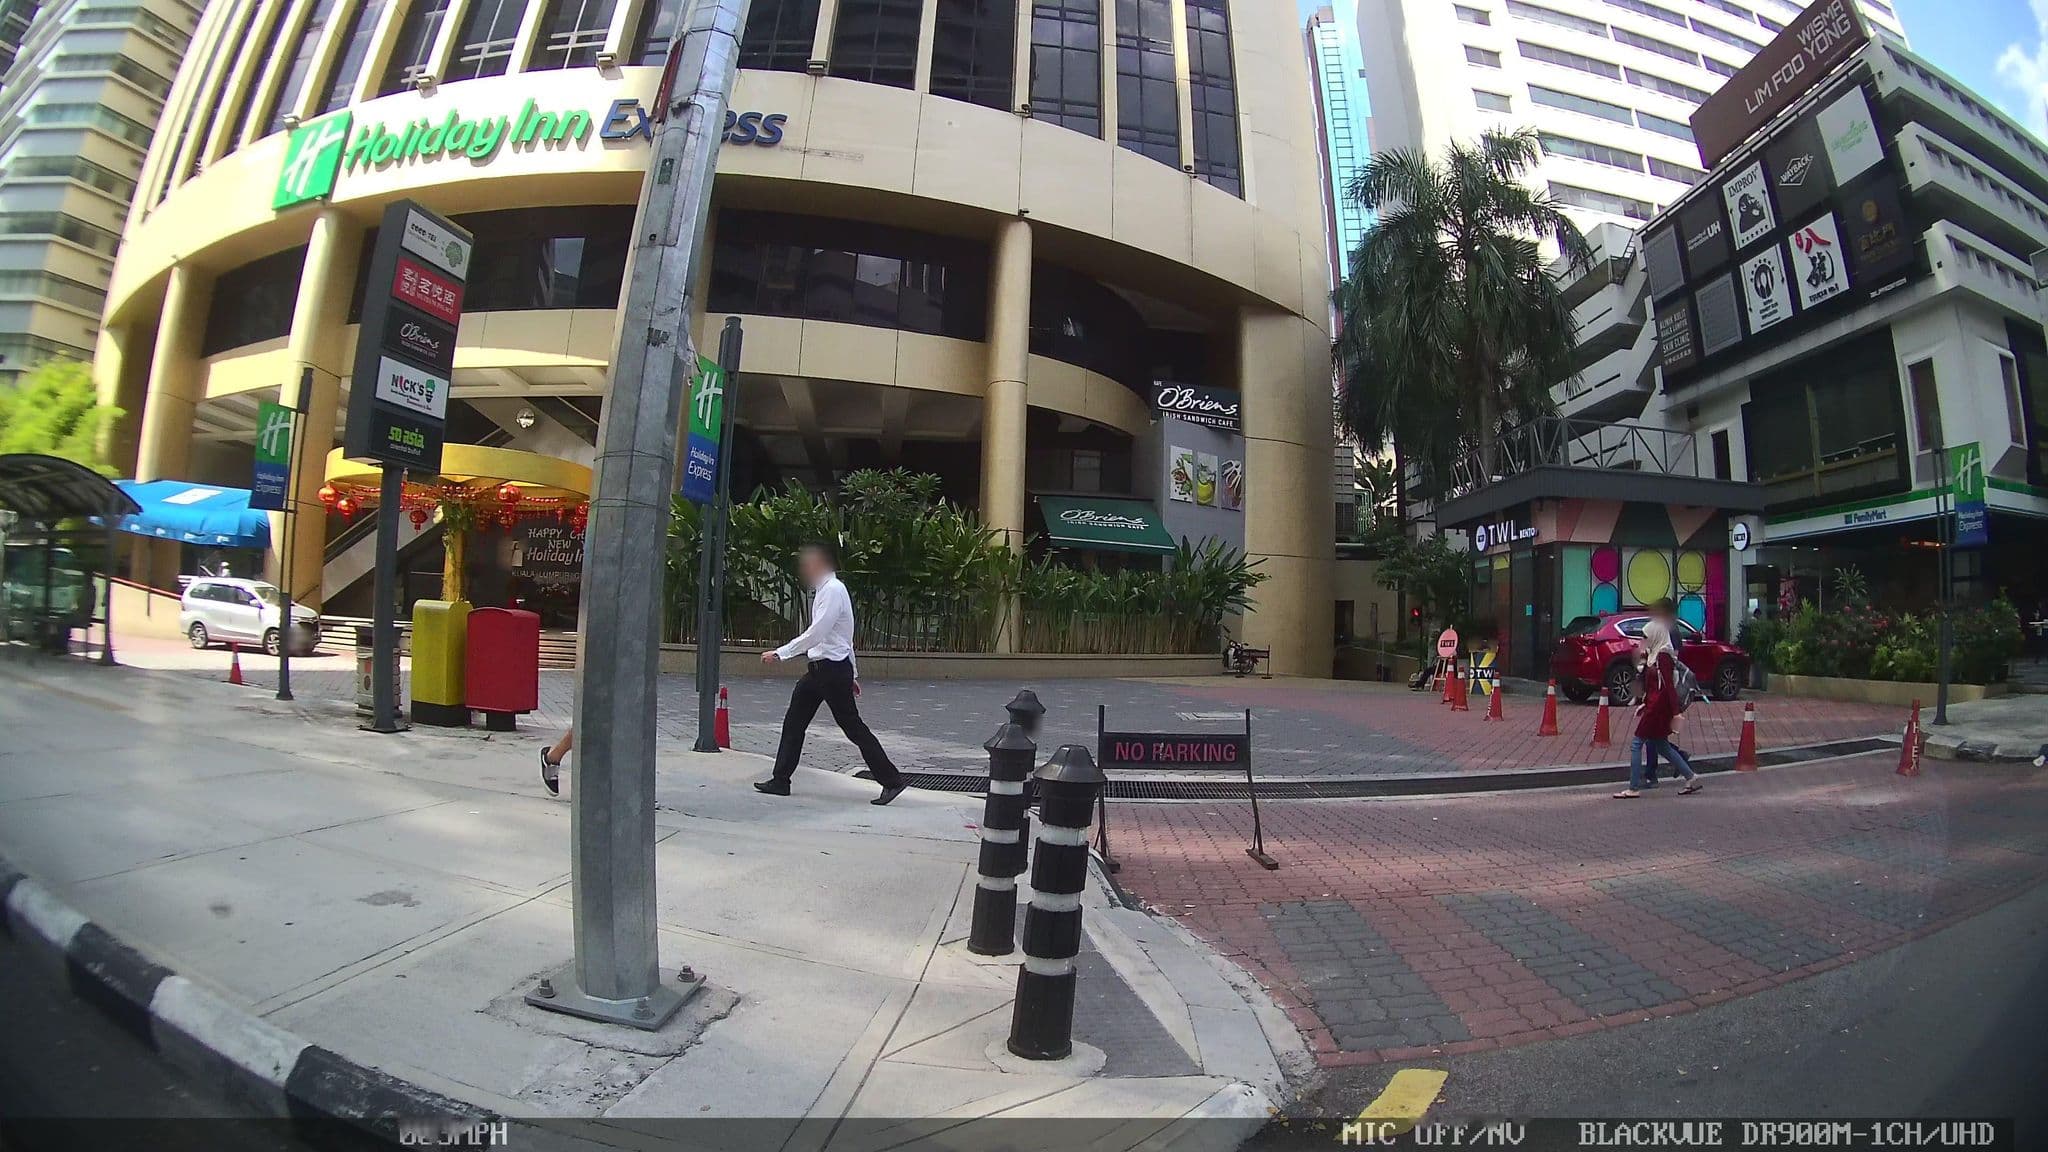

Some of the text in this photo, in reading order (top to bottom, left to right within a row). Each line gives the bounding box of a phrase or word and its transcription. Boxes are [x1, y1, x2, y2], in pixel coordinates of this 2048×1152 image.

[1797, 0, 1844, 45] WISMA
[1745, 81, 1772, 114] LIM
[1772, 53, 1805, 91] FOO
[1803, 13, 1851, 60] YONG
[345, 97, 788, 169] Holiday Inn Exess
[1728, 169, 1758, 197] IMPROV
[1707, 220, 1721, 238] UH
[400, 321, 440, 349] O'Briens
[391, 373, 425, 397] NICK'S
[1158, 385, 1239, 415] O'Briens
[1162, 411, 1234, 428] IRISH SANDWICH CAFE
[691, 446, 709, 465] Holiday
[688, 460, 713, 481] Express
[1060, 508, 1144, 524] O'Briens
[1853, 507, 1888, 524] FamilyMart
[528, 528, 563, 538] HAPPY
[1488, 520, 1518, 546] TWL
[548, 540, 571, 549] NEW
[527, 547, 574, 566] Holiday
[1115, 742, 1236, 762] NO PARKING
